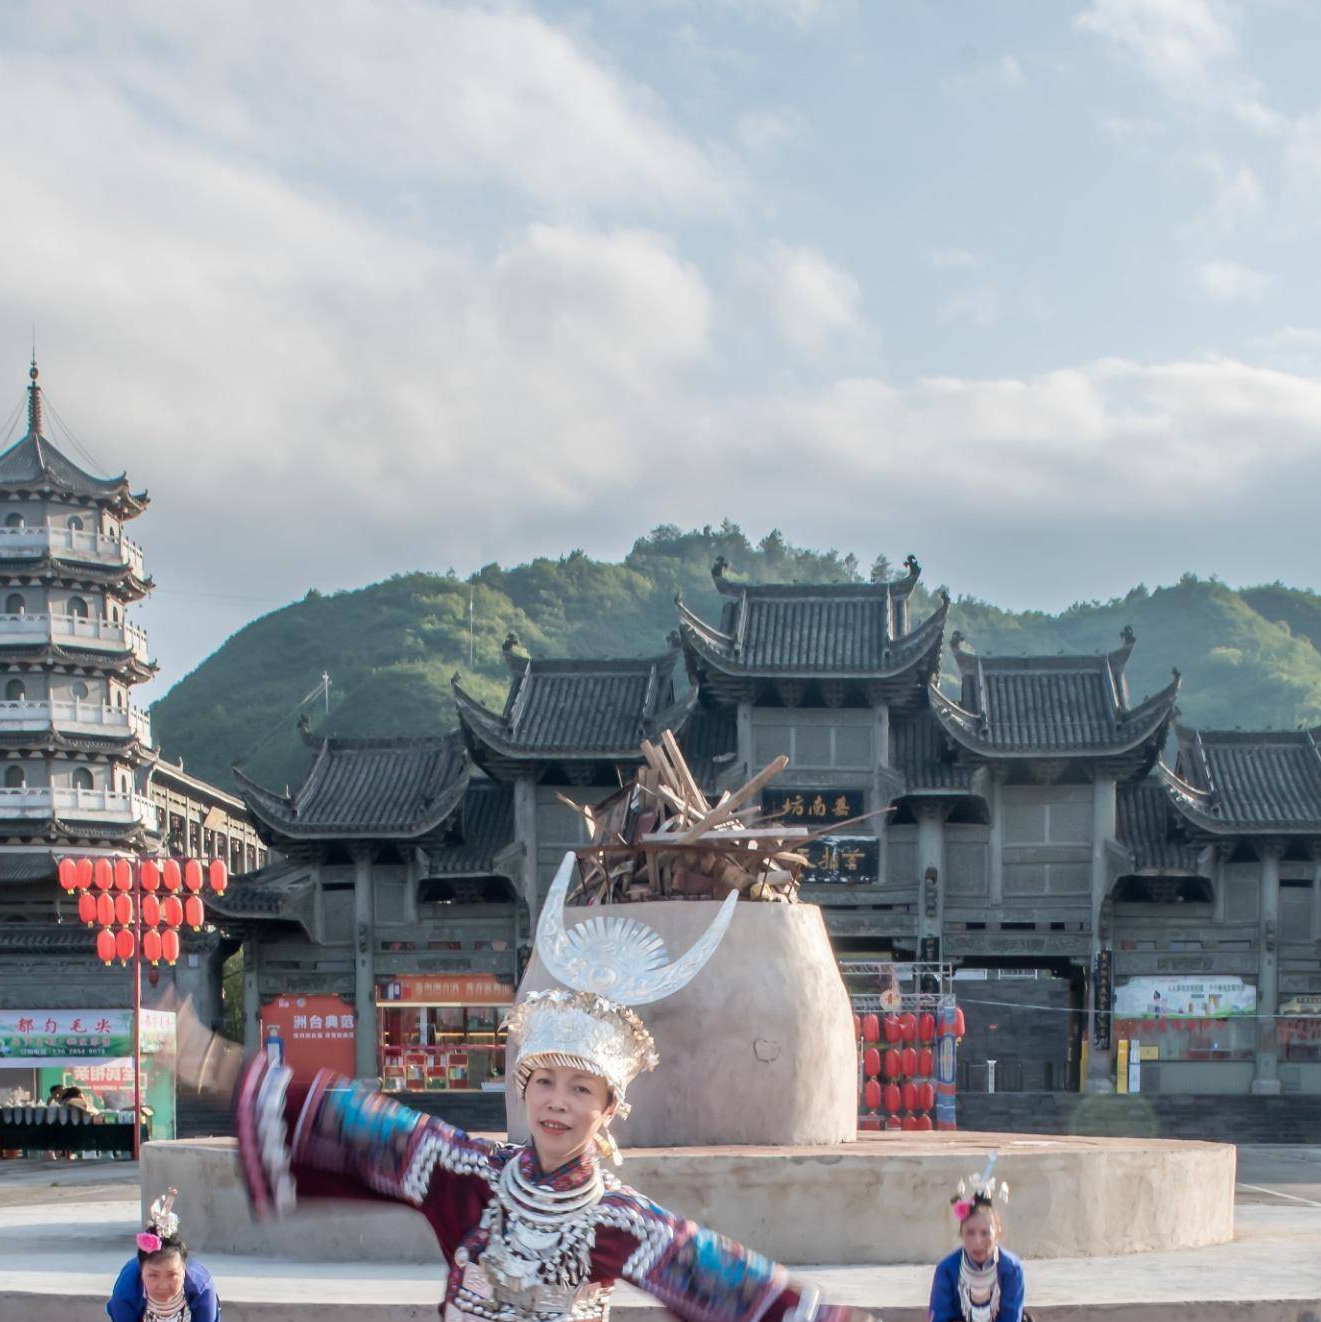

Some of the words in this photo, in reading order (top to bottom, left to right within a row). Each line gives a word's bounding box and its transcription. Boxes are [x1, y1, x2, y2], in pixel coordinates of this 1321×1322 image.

[14, 1017, 112, 1034] 都匀毛尖
[293, 1014, 355, 1030] 洲台典范
